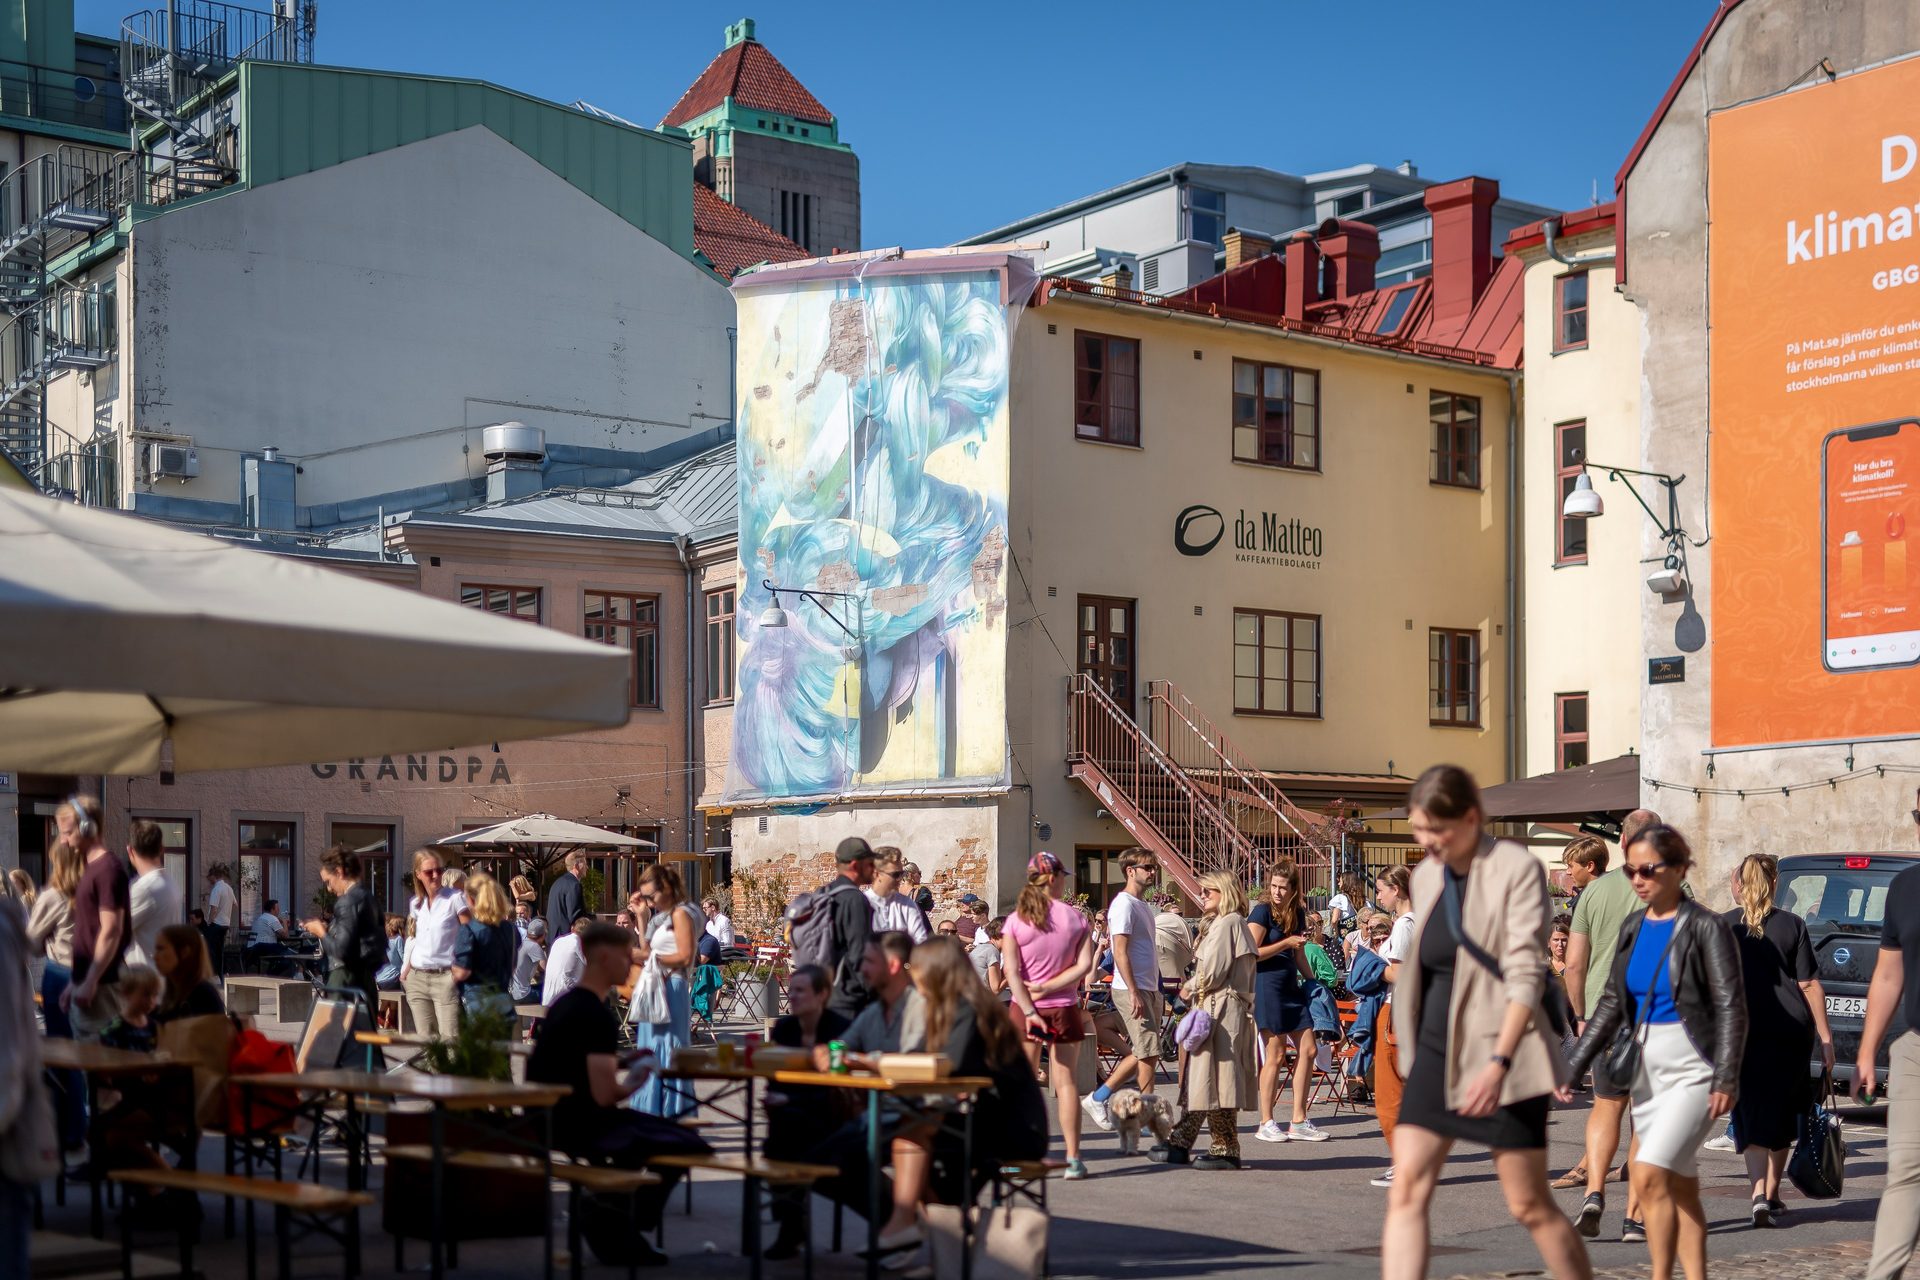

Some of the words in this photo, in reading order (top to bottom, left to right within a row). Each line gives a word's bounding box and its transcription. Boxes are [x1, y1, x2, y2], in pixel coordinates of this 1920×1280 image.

[1872, 263, 1920, 291] GBG
[1786, 341, 1801, 356] På
[1803, 336, 1840, 353] Mat.se
[1841, 326, 1878, 348] jämför
[1880, 324, 1895, 338] du
[1786, 360, 1801, 375] får
[1803, 354, 1840, 371] förslag
[1842, 348, 1857, 366] på
[1859, 346, 1881, 360] mer
[1786, 369, 1867, 393] stockholmarna
[1869, 362, 1903, 377] vilken
[1234, 509, 1257, 551] da
[1262, 511, 1322, 557] Matteo
[1235, 553, 1321, 570] KAFFEAKTIEBOLAGET
[311, 754, 512, 784] GRANDPA
[1844, 999, 1866, 1012] 25
